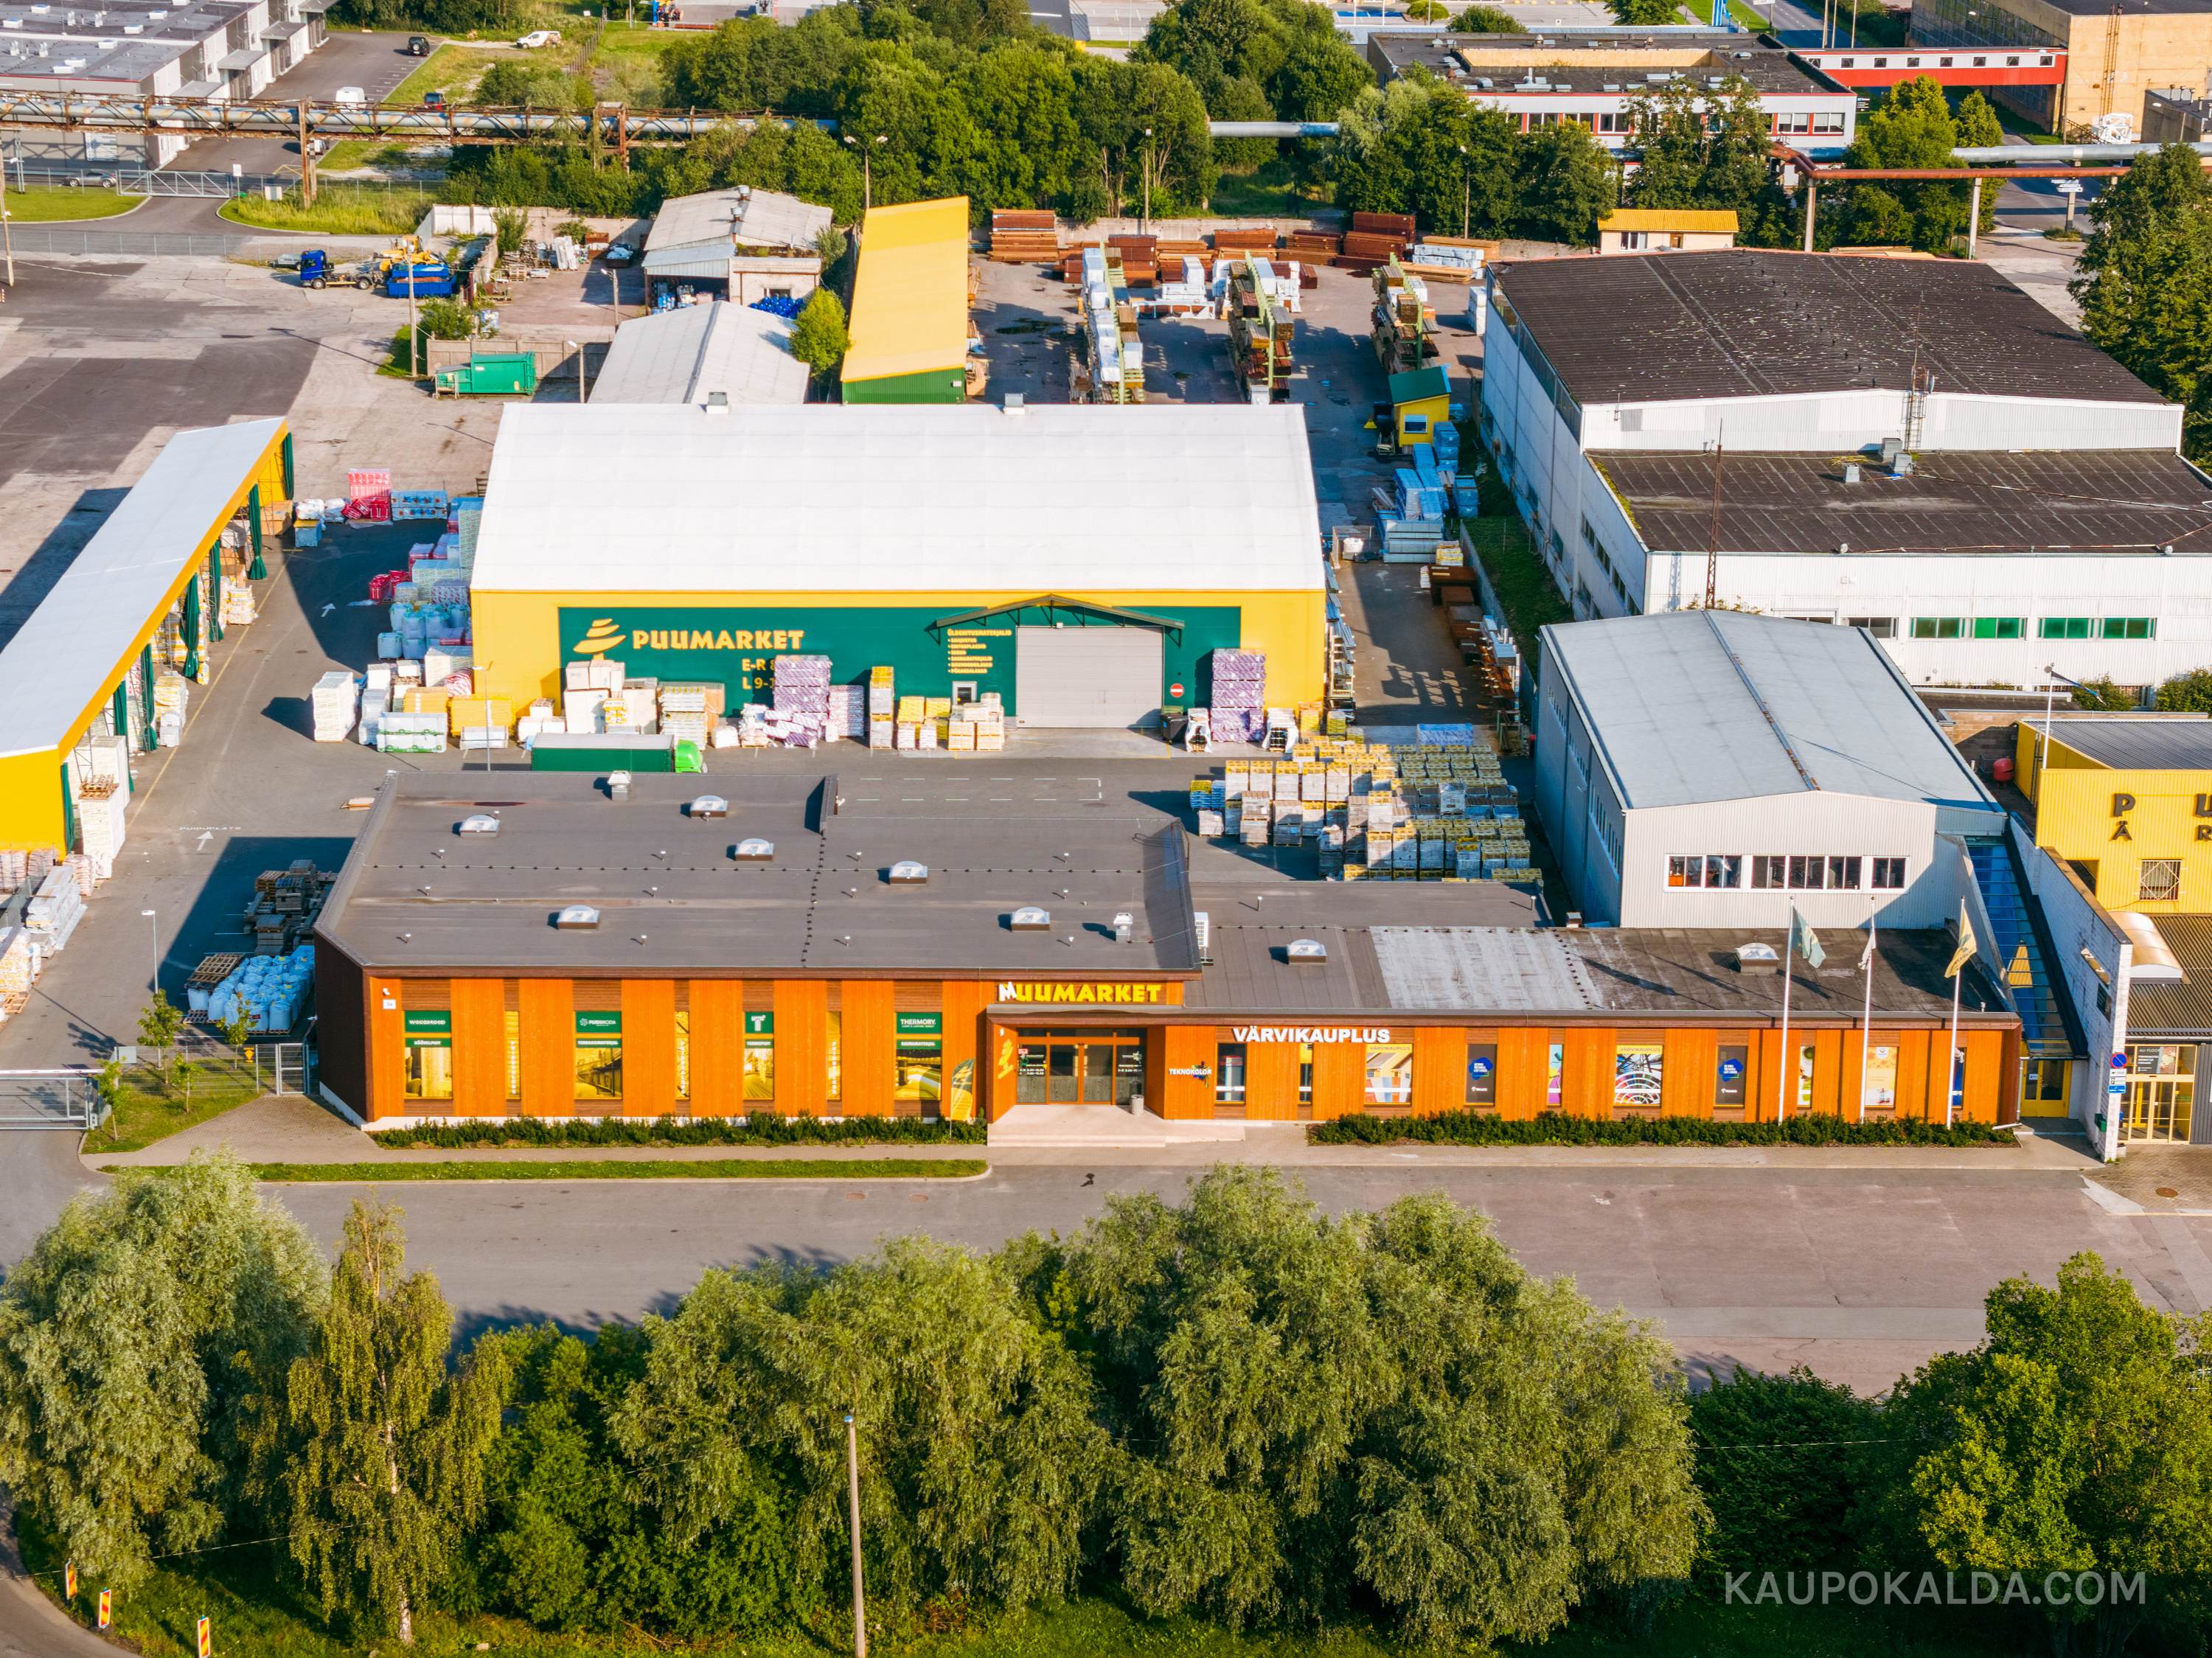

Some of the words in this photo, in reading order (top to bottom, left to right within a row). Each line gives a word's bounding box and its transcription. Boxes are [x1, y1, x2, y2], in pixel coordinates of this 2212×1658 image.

[632, 629, 805, 650] PUUMARKET
[741, 658, 766, 672] E-R
[742, 677, 751, 689] L
[998, 981, 1161, 1003] MUUMARKET
[1233, 1025, 1391, 1043] VÄRVIKAUPLUS
